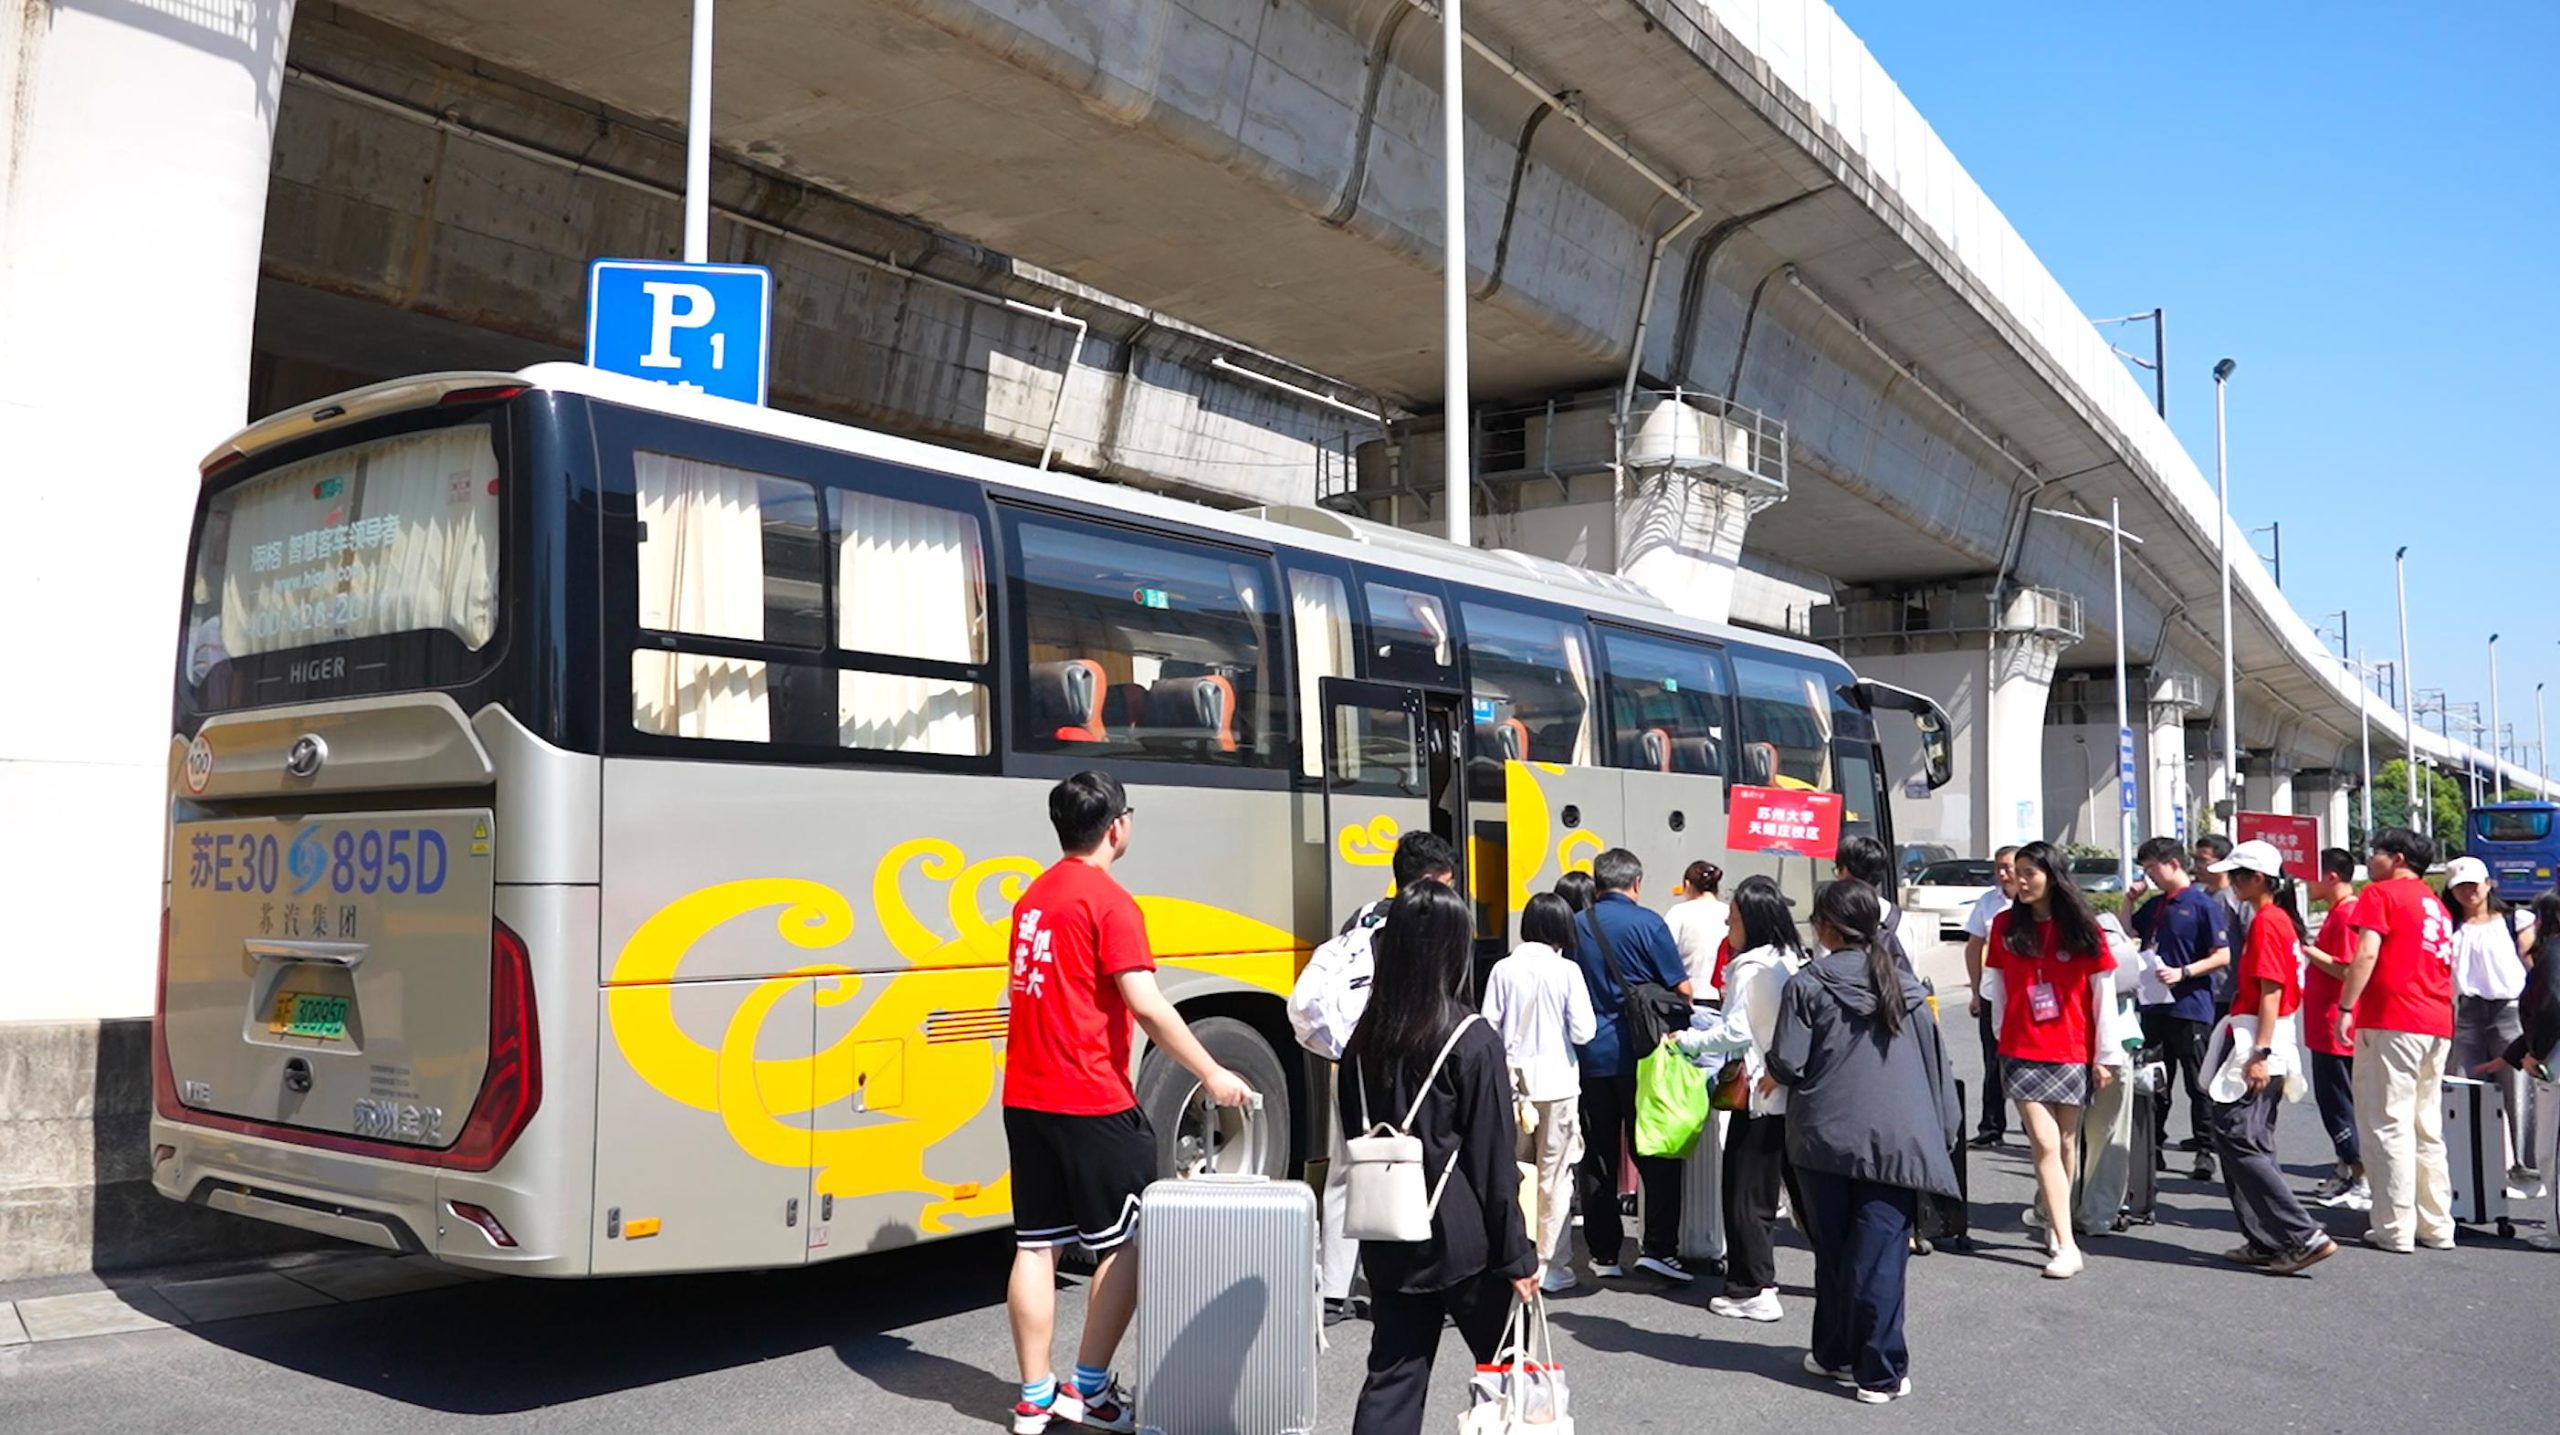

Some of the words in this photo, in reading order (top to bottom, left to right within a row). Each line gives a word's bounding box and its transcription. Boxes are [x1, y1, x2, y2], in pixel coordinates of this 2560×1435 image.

[250, 541, 283, 572] 海格
[288, 513, 401, 565] 智慧客车领导者
[290, 657, 345, 684] HIGER
[1756, 806, 1815, 824] 苏州大学
[331, 829, 447, 895] 895D
[259, 902, 357, 938] 苏汽集团
